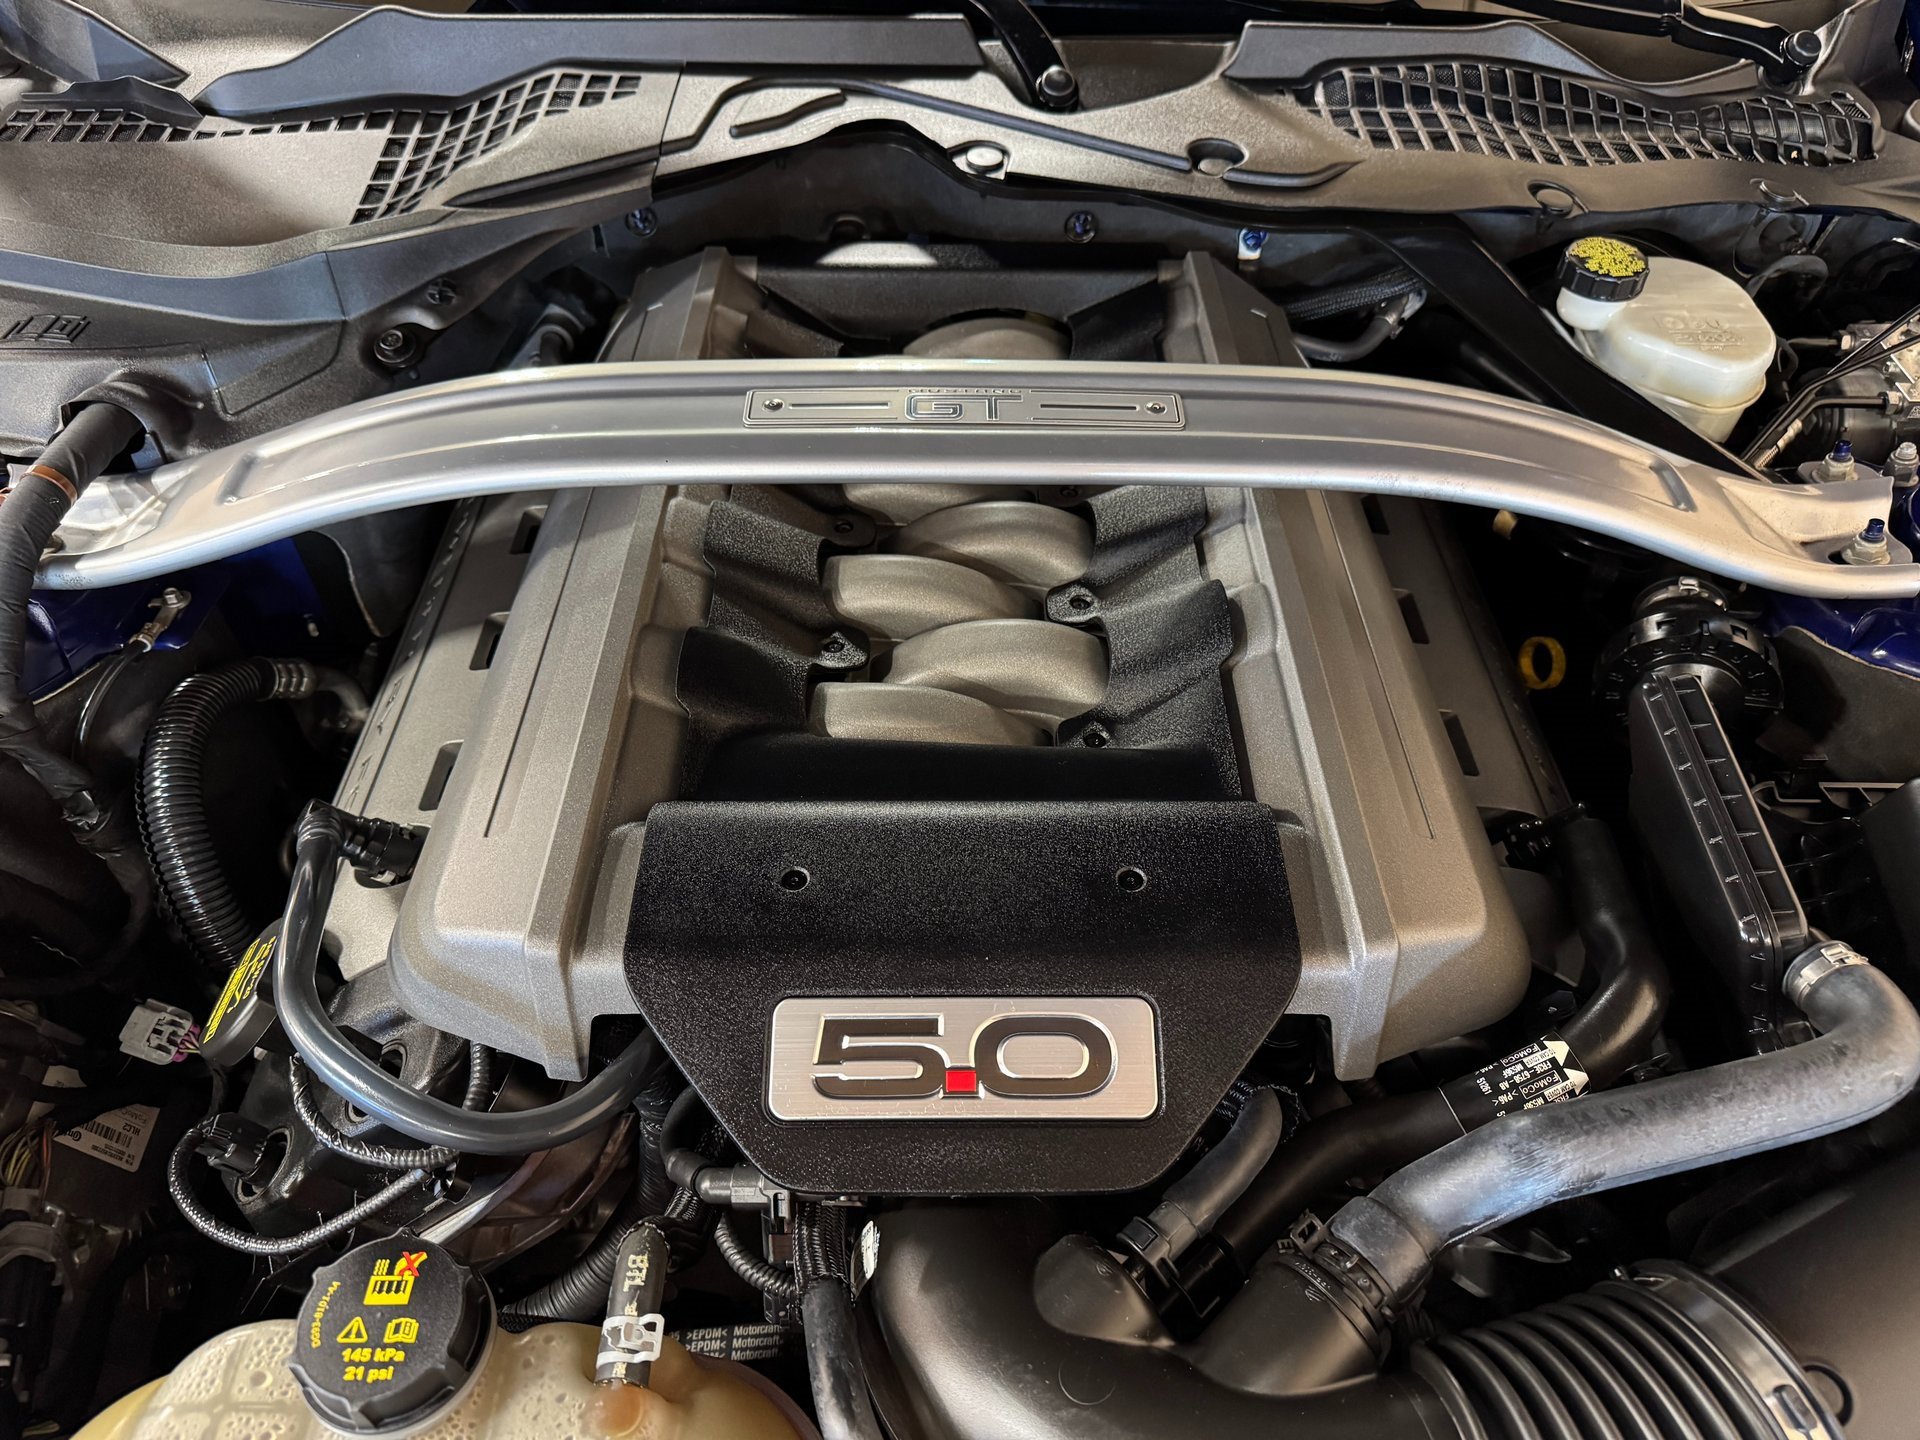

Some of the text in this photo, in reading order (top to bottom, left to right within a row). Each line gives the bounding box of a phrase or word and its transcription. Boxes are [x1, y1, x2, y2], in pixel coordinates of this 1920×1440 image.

[905, 393, 1024, 421] GT
[812, 1012, 1118, 1099] 5.0
[1503, 1045, 1538, 1064] FoMoCo
[1522, 1073, 1559, 1094] FoMoCo
[732, 1335, 780, 1349] Motorcraft
[342, 1347, 405, 1363] 145 kPa
[343, 1365, 394, 1384] 21 psi
